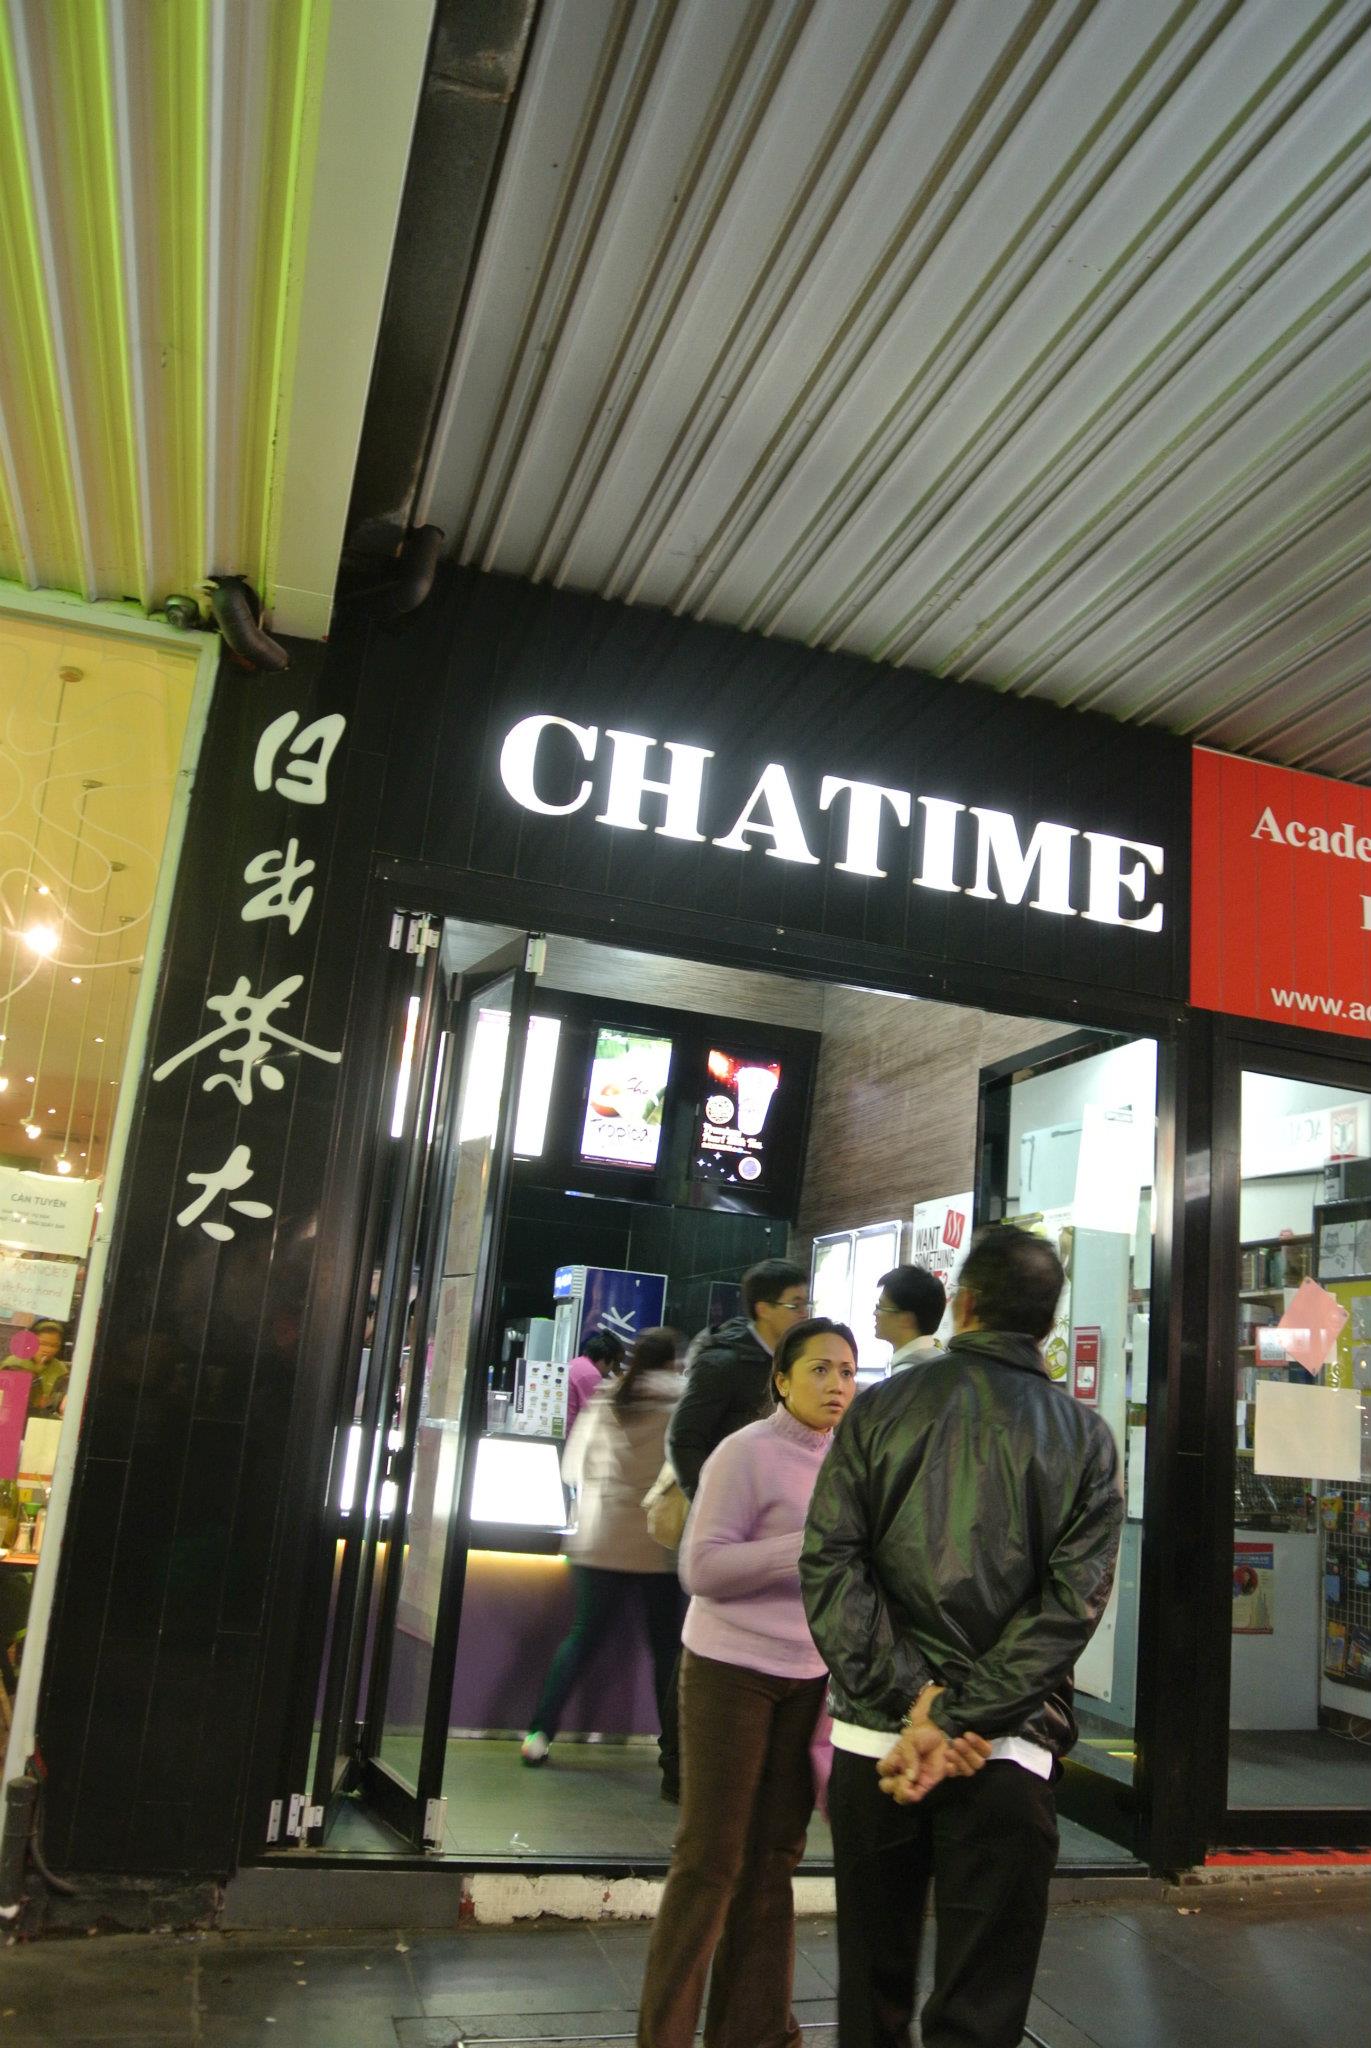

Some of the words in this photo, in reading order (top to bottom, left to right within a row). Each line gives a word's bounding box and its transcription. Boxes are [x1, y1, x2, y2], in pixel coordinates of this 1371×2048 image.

[499, 714, 1165, 933] CHATIME
[152, 709, 347, 1242] 日出茶太
[915, 1226, 941, 1252] WANT
